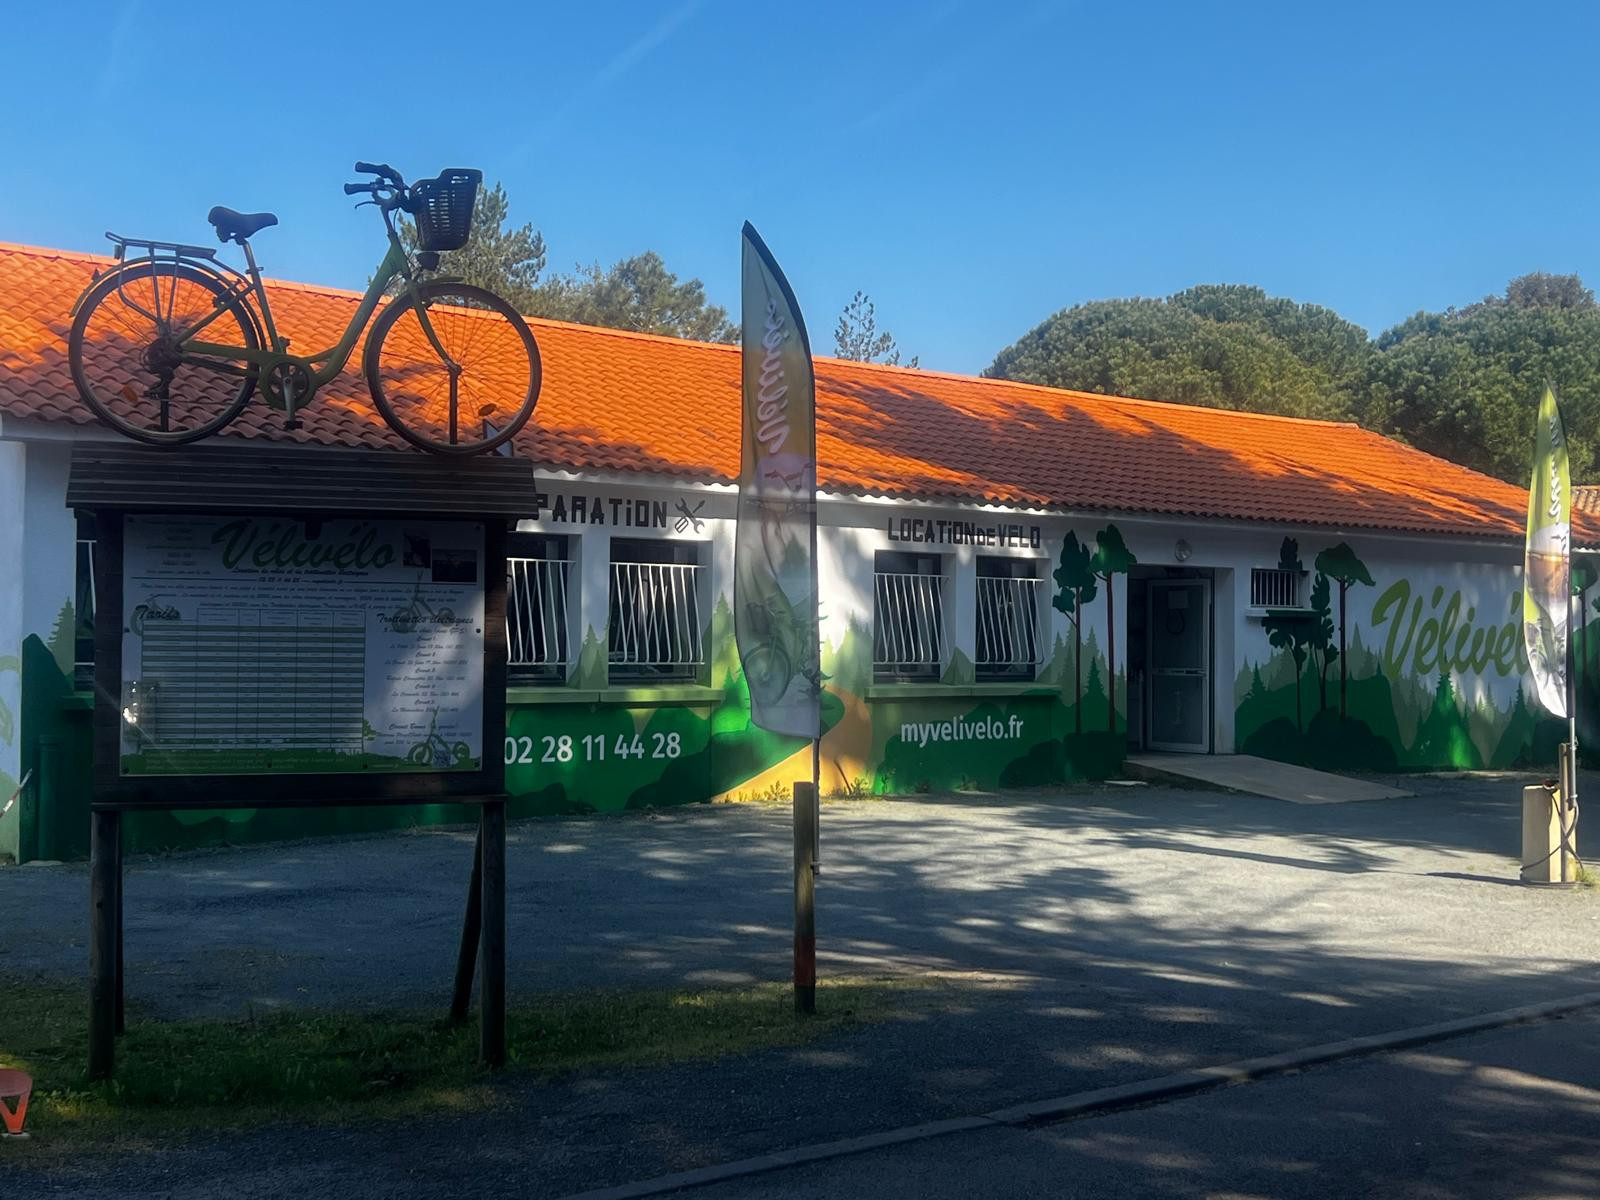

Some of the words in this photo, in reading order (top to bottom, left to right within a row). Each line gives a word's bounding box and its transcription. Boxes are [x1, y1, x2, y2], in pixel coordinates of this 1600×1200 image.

[998, 523, 1040, 549] VELO
[1371, 578, 1531, 681] Vélivél
[901, 714, 1024, 748] myvelivelo.fr
[504, 736, 533, 765] 02
[541, 735, 573, 762] 28
[581, 735, 605, 761] 11
[614, 734, 645, 760] 44
[652, 732, 681, 758] 28
